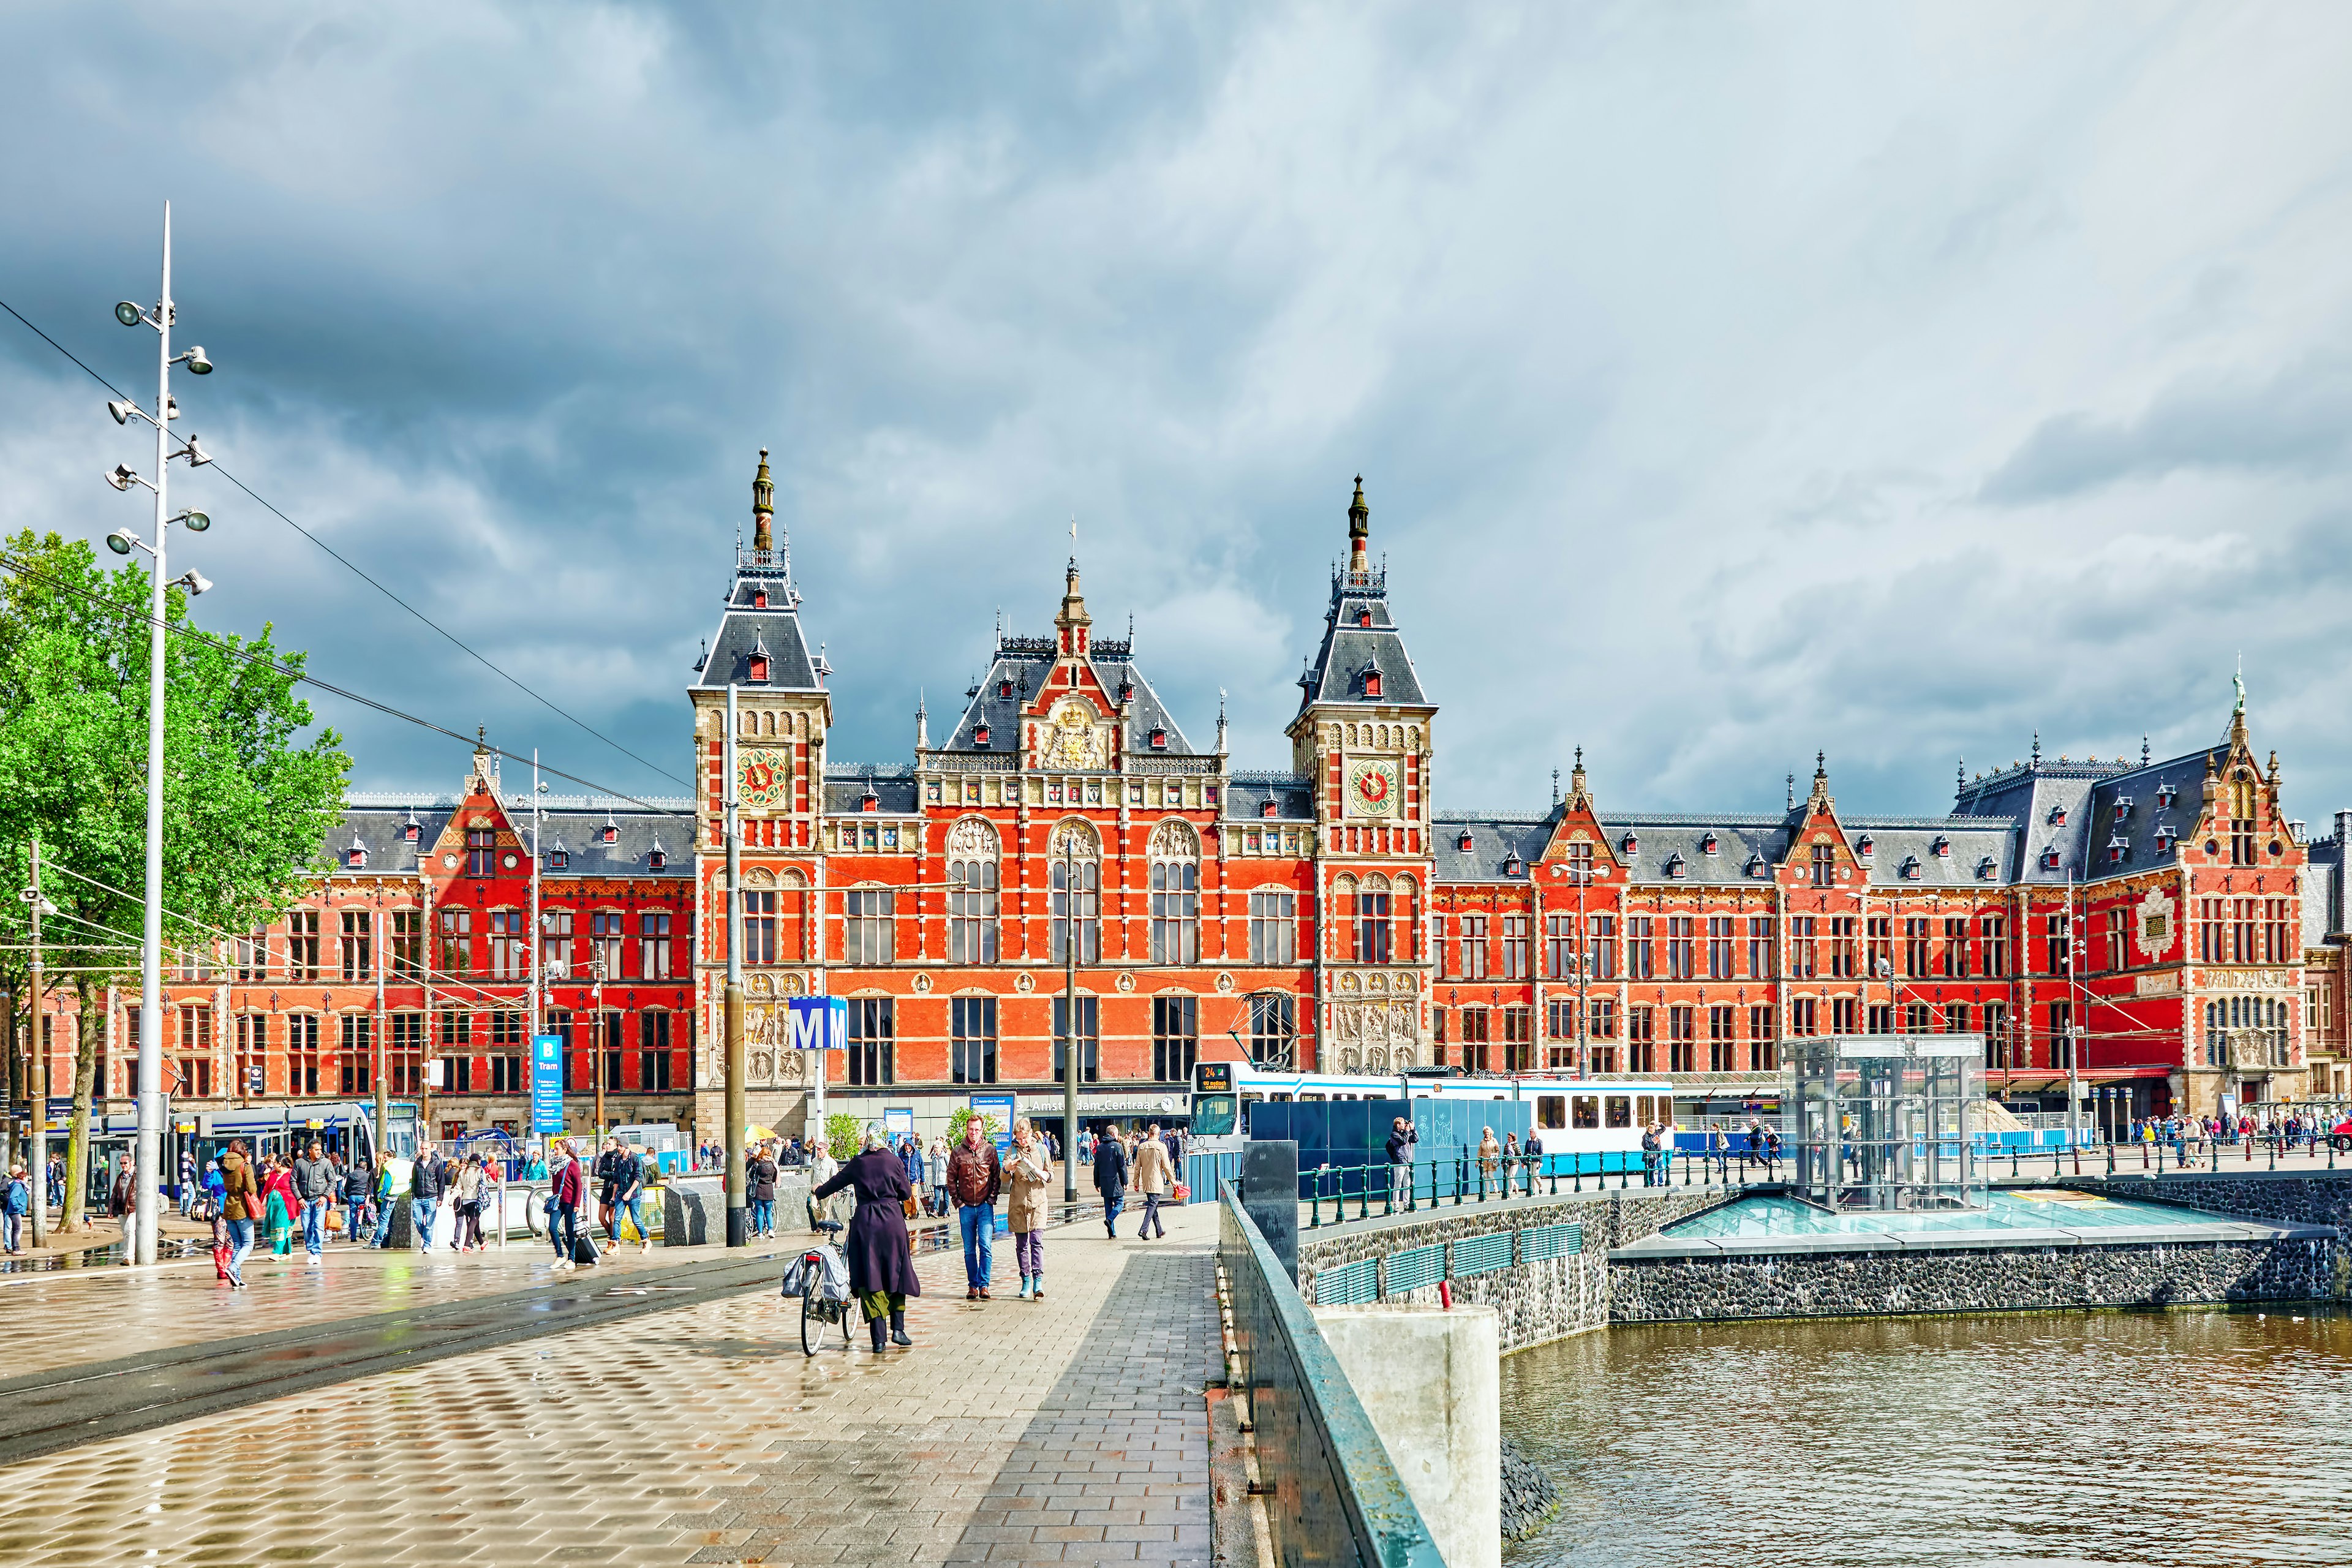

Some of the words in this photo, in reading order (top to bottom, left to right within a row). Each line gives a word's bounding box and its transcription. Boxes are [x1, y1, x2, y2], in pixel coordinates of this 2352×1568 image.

[789, 1008, 823, 1049] M
[830, 1008, 845, 1049] M
[543, 1042, 554, 1057] B
[1205, 1067, 1215, 1078] 24
[1031, 1100, 1101, 1111] Amstdam
[1104, 1099, 1156, 1110] Centraal
